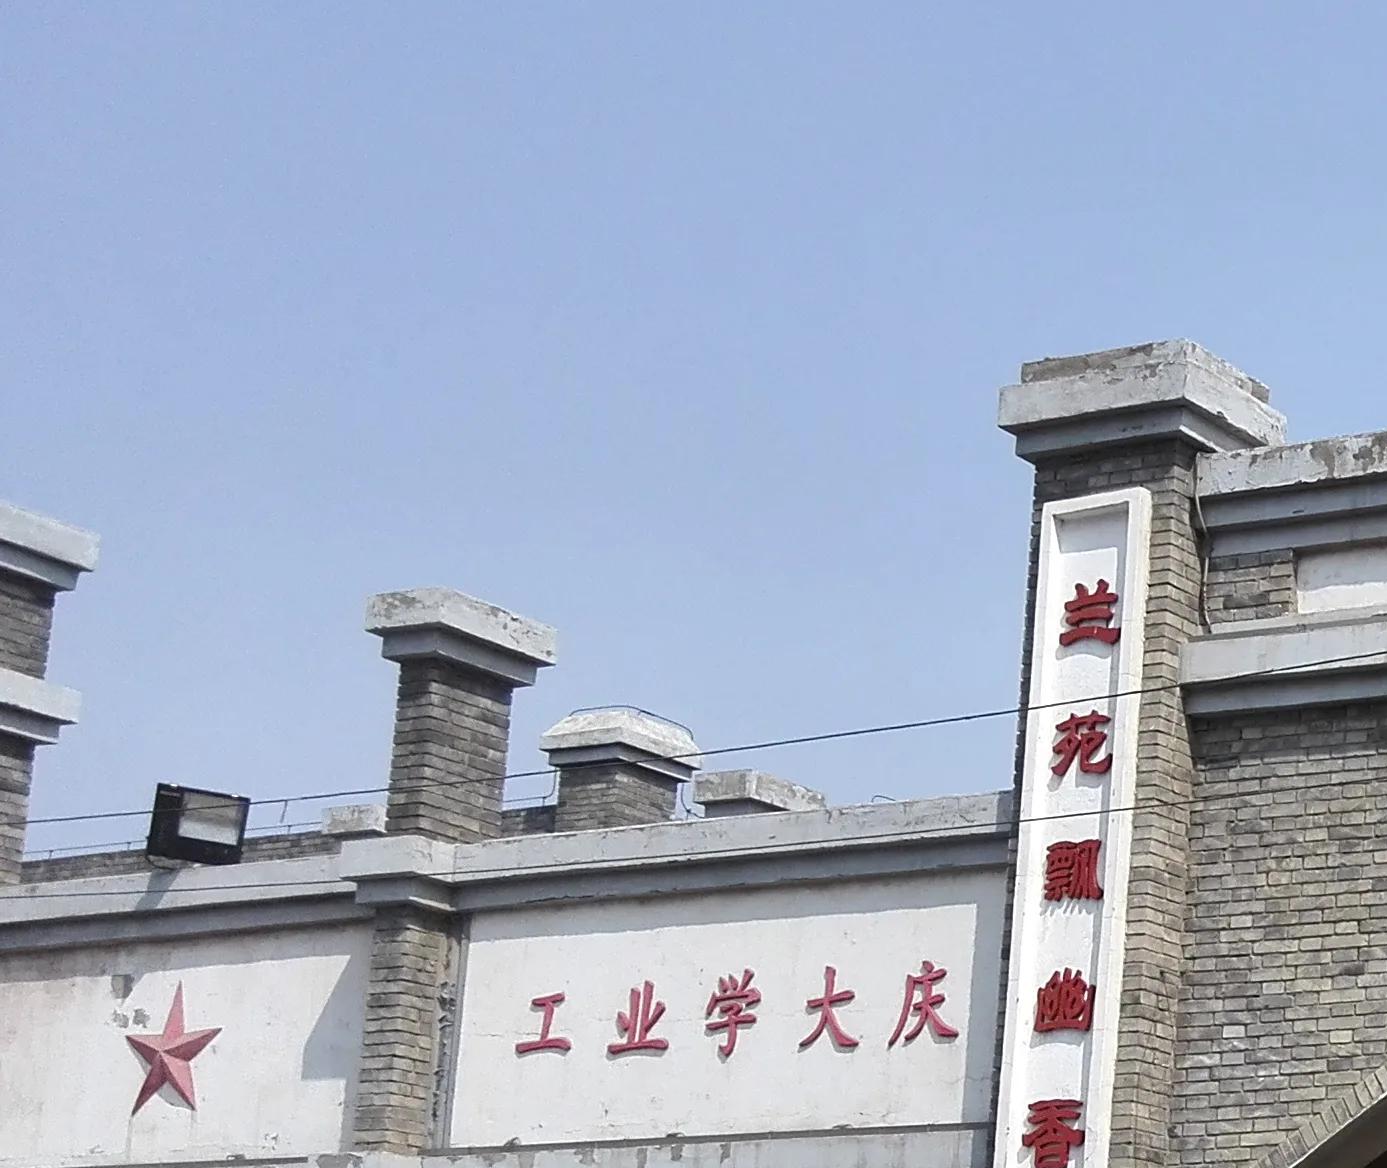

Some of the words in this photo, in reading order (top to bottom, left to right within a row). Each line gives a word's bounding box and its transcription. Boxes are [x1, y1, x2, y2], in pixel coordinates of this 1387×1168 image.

[514, 960, 960, 1060] 工业学大庆
